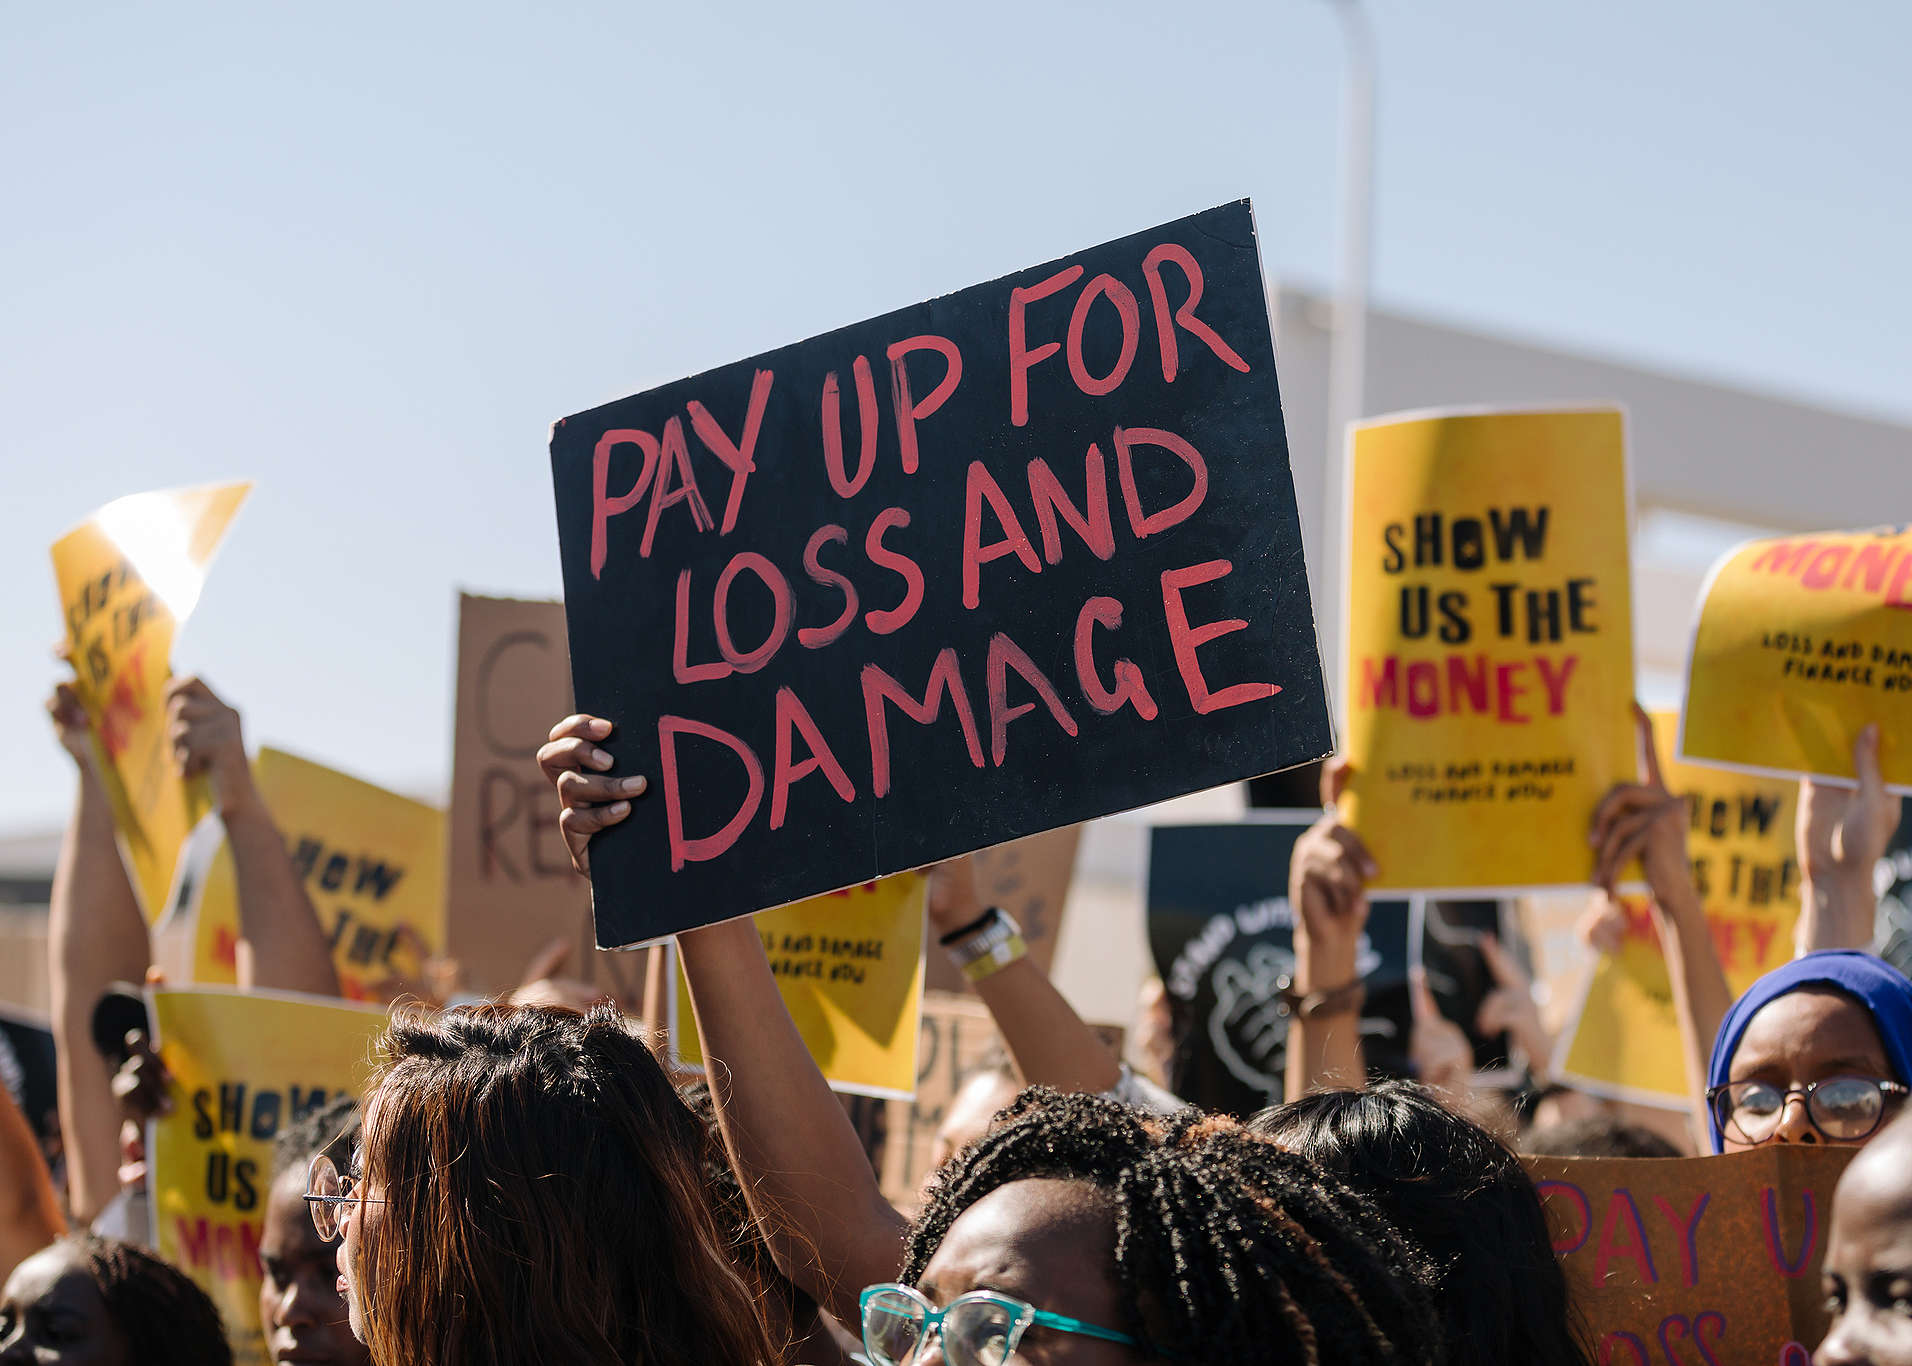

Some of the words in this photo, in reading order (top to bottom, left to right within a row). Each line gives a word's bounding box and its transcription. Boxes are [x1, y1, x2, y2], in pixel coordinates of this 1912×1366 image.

[592, 369, 773, 580] PAY
[821, 335, 963, 498] UP
[1009, 243, 1250, 426] FOR
[673, 507, 926, 684] LOSS
[962, 426, 1208, 610] AND
[1383, 506, 1550, 575] SHOW
[1752, 542, 1912, 611] MONE
[1400, 584, 1472, 645] US
[1489, 578, 1599, 645] THE
[1762, 632, 1812, 654] LOSS
[1821, 640, 1863, 659] AND
[1871, 645, 1912, 668] DAM
[1783, 658, 1875, 686] FINANCE
[1884, 674, 1912, 692] NO
[658, 559, 1283, 873] DAMAGE
[1360, 655, 1579, 724] MONEY
[293, 836, 403, 901] HOW
[769, 959, 823, 979] NANCE
[206, 1151, 257, 1212] US
[175, 1214, 264, 1282] MON
[1536, 1179, 1712, 1290] PAY
[1760, 1187, 1820, 1279] U
